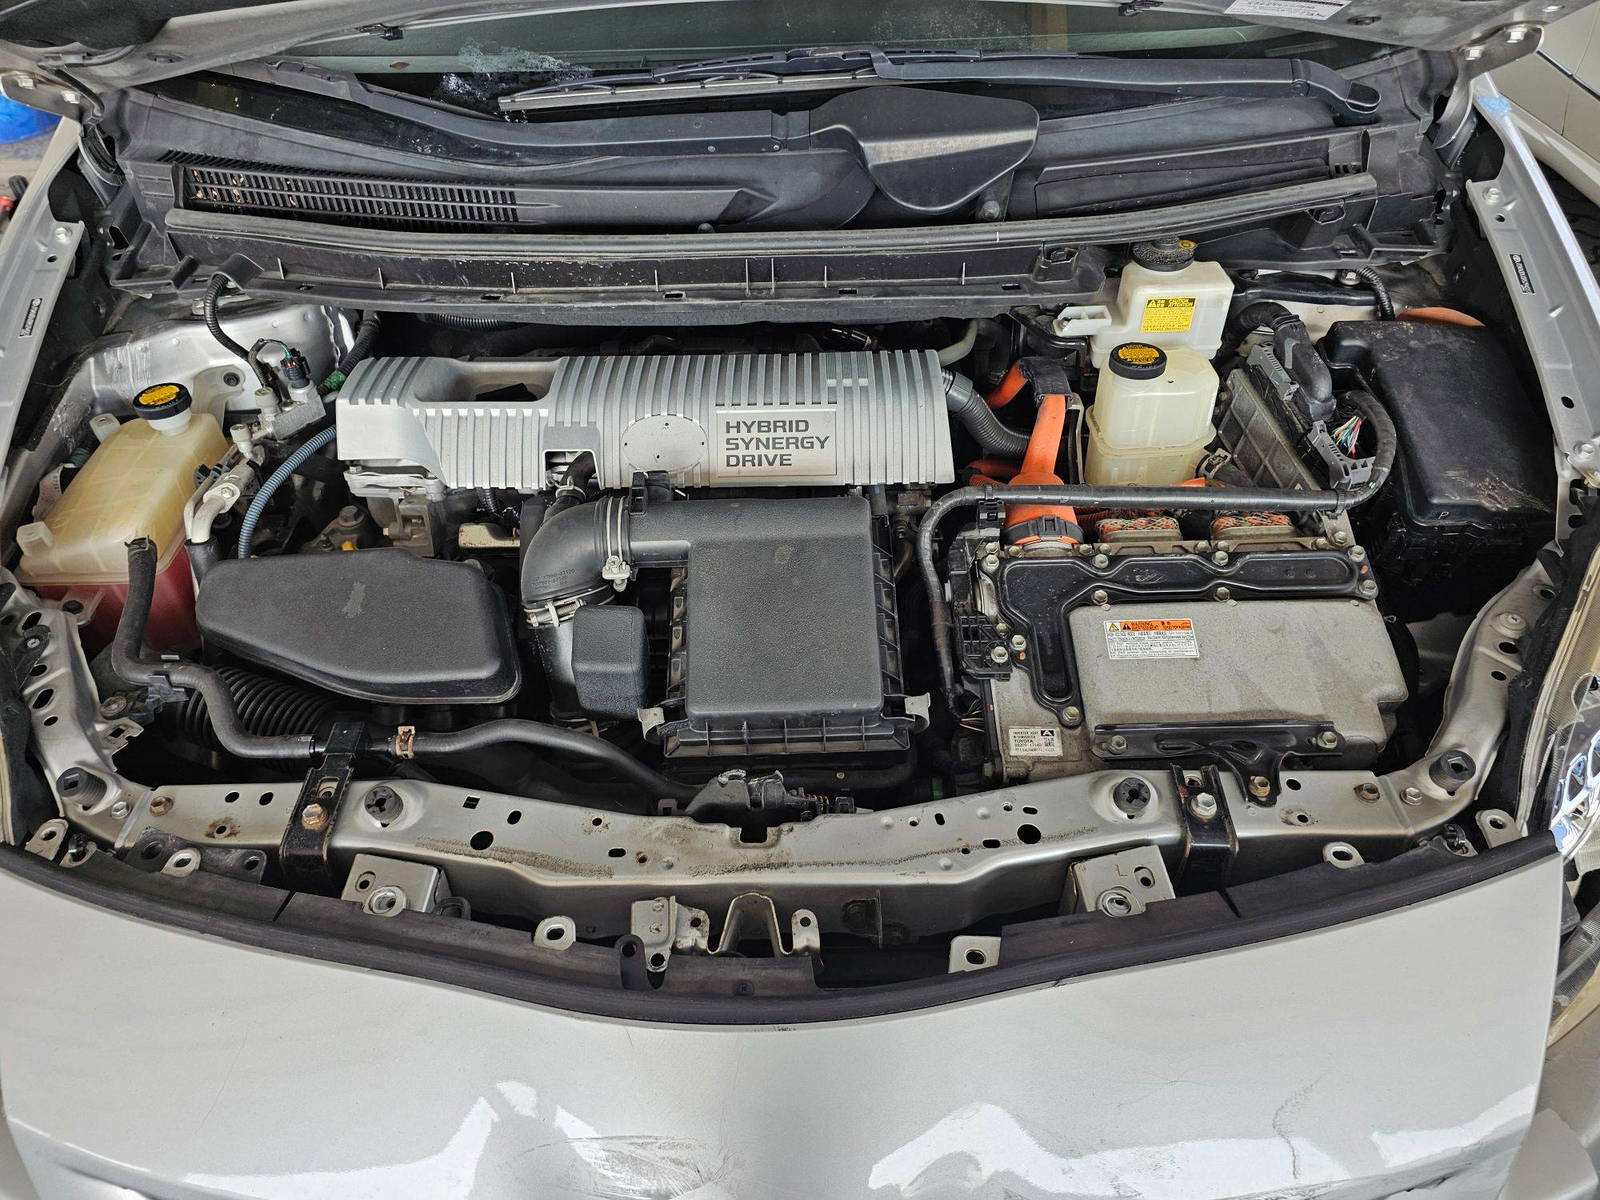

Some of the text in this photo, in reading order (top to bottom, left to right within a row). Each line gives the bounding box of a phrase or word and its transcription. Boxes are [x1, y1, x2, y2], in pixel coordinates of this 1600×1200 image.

[725, 420, 809, 434] HYBRID
[725, 436, 830, 451] SYNERGY
[726, 454, 792, 467] DRIVE
[1438, 511, 1449, 520] P
[1115, 864, 1128, 877] L
